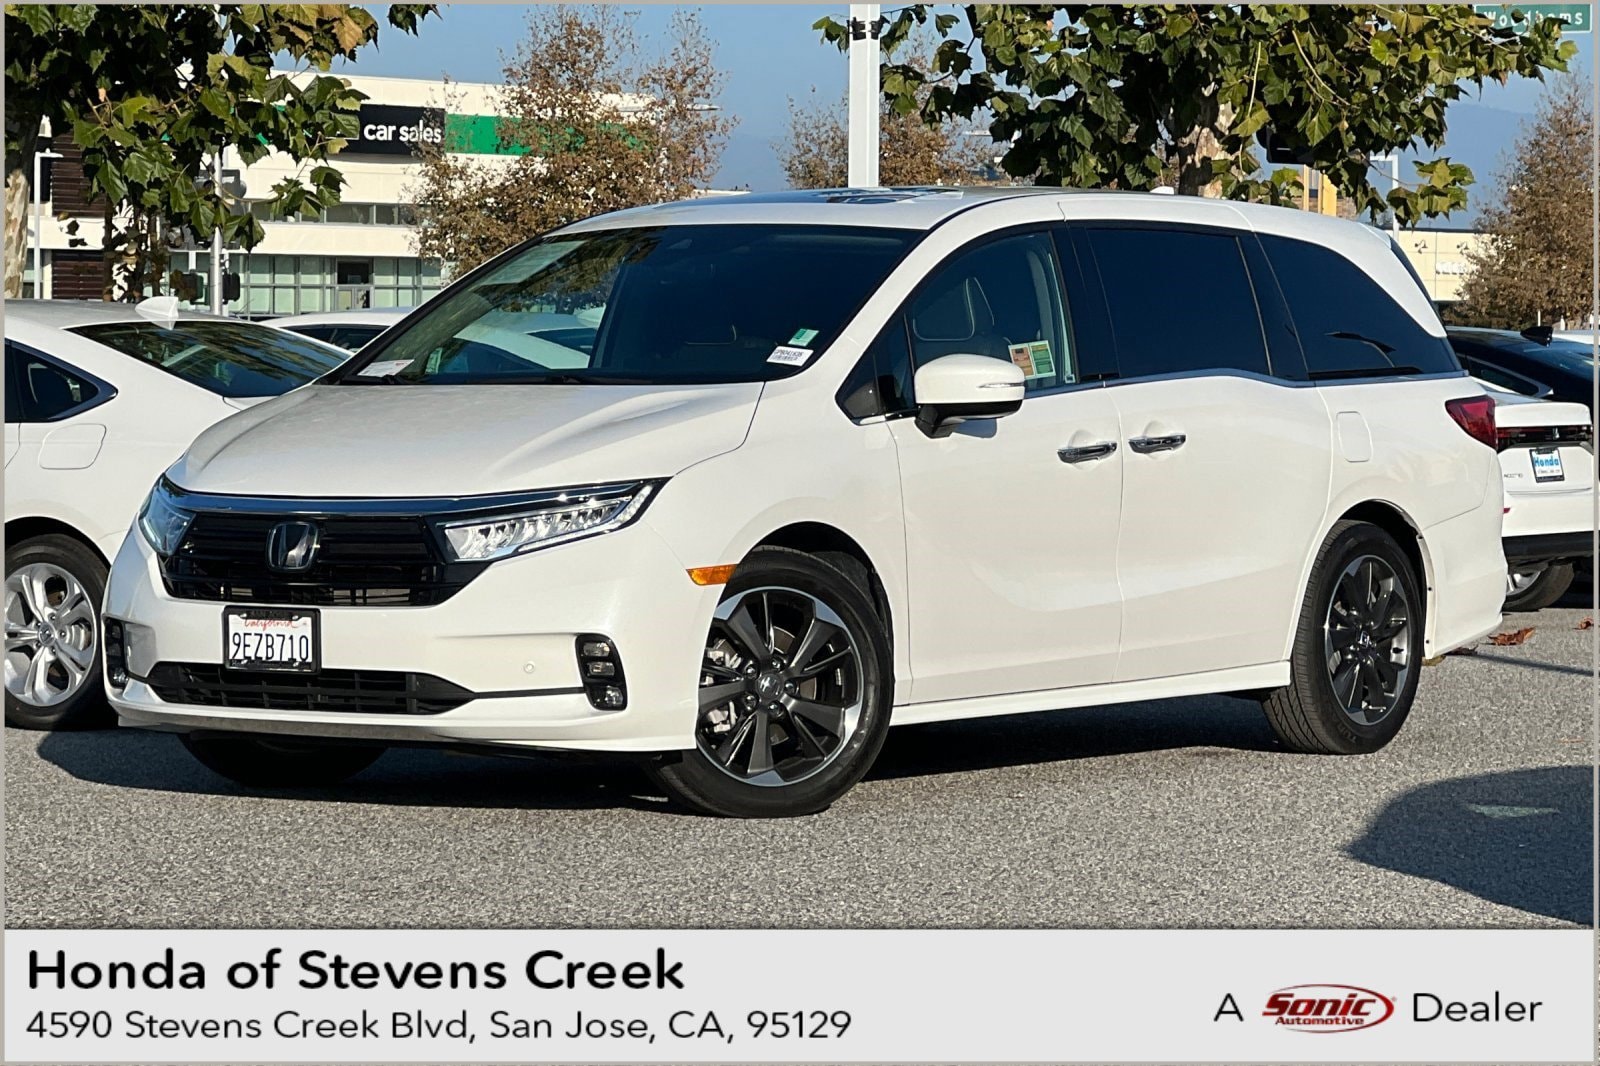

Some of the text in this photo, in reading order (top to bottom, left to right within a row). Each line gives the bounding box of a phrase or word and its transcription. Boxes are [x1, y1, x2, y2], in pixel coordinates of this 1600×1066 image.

[363, 119, 442, 143] car sales
[1534, 456, 1560, 467] Honda
[232, 632, 309, 662] 9EZB710
